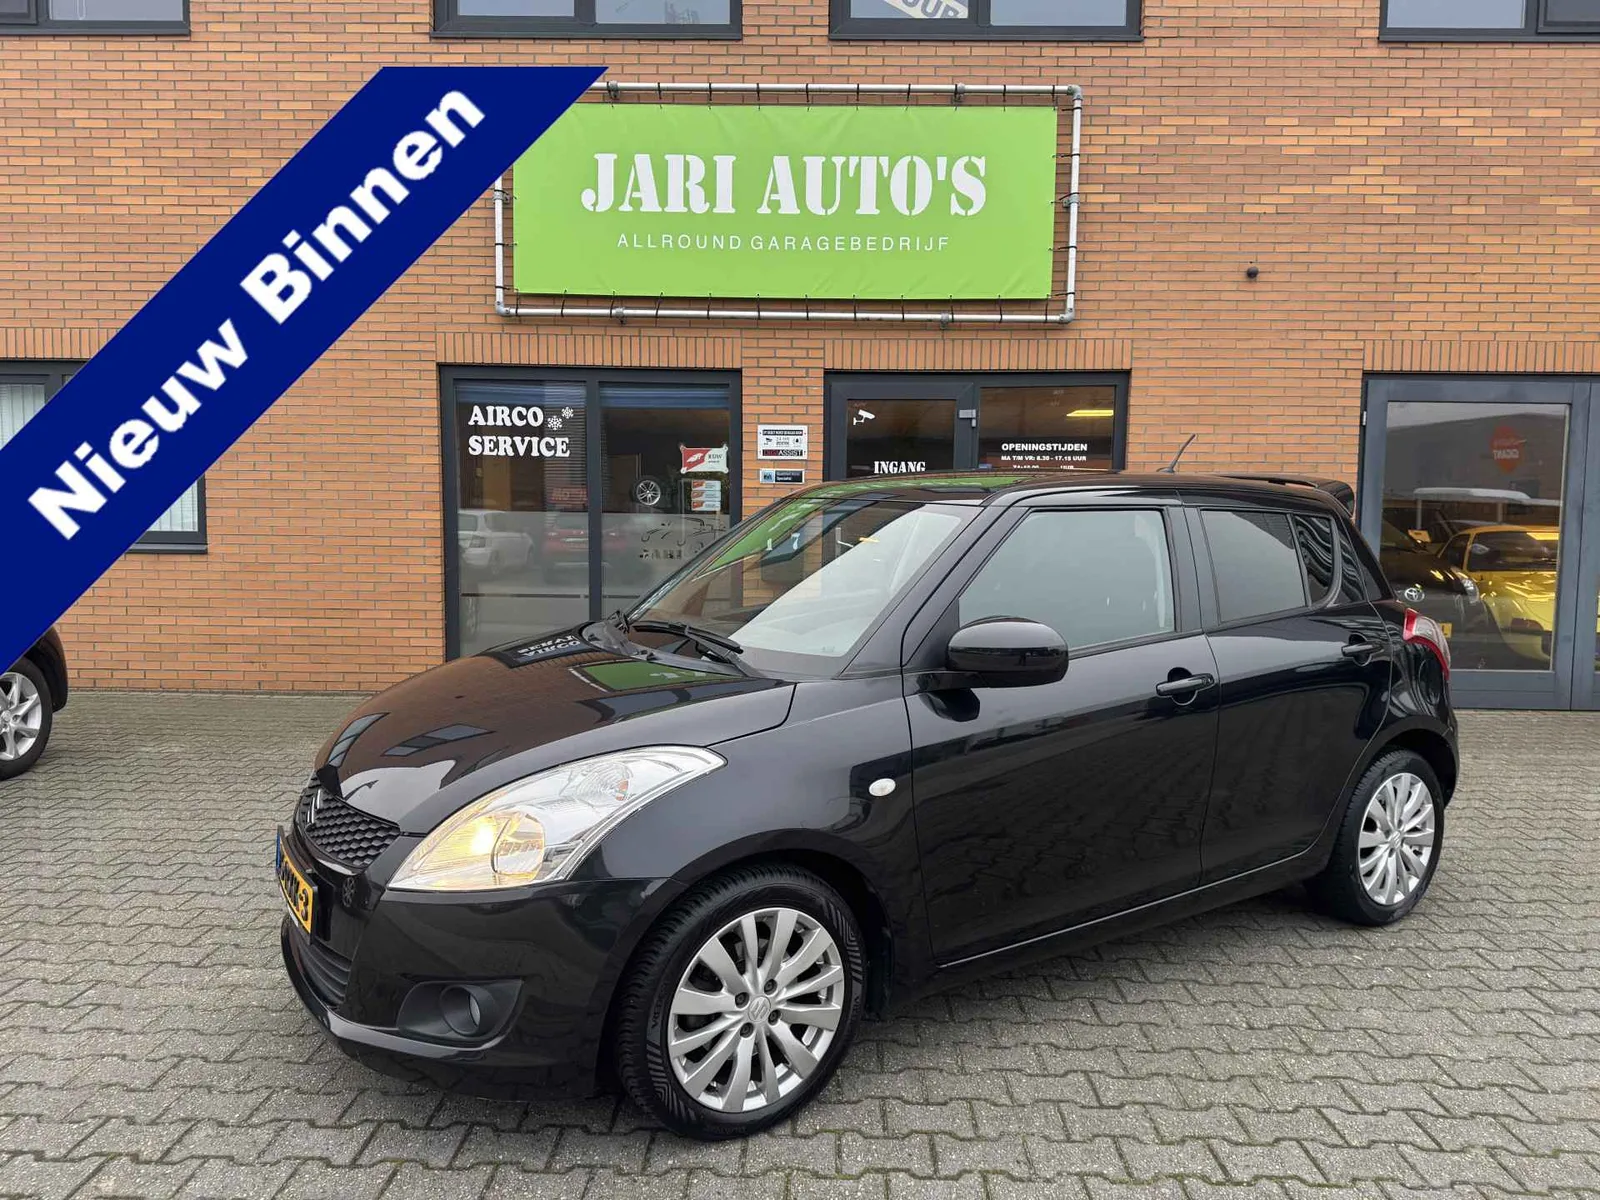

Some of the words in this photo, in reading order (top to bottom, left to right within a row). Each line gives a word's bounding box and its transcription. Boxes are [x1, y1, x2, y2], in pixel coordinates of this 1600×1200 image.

[580, 152, 737, 215] JARI
[756, 154, 988, 218] AUTO'S
[617, 233, 742, 250] ALLROUND
[750, 235, 950, 252] GARAGEBEDRIJF
[467, 405, 544, 428] AIRCO
[467, 435, 571, 458] SERVICE
[1001, 443, 1088, 452] OPENINGSTIJDEN
[873, 460, 926, 474] INGANG
